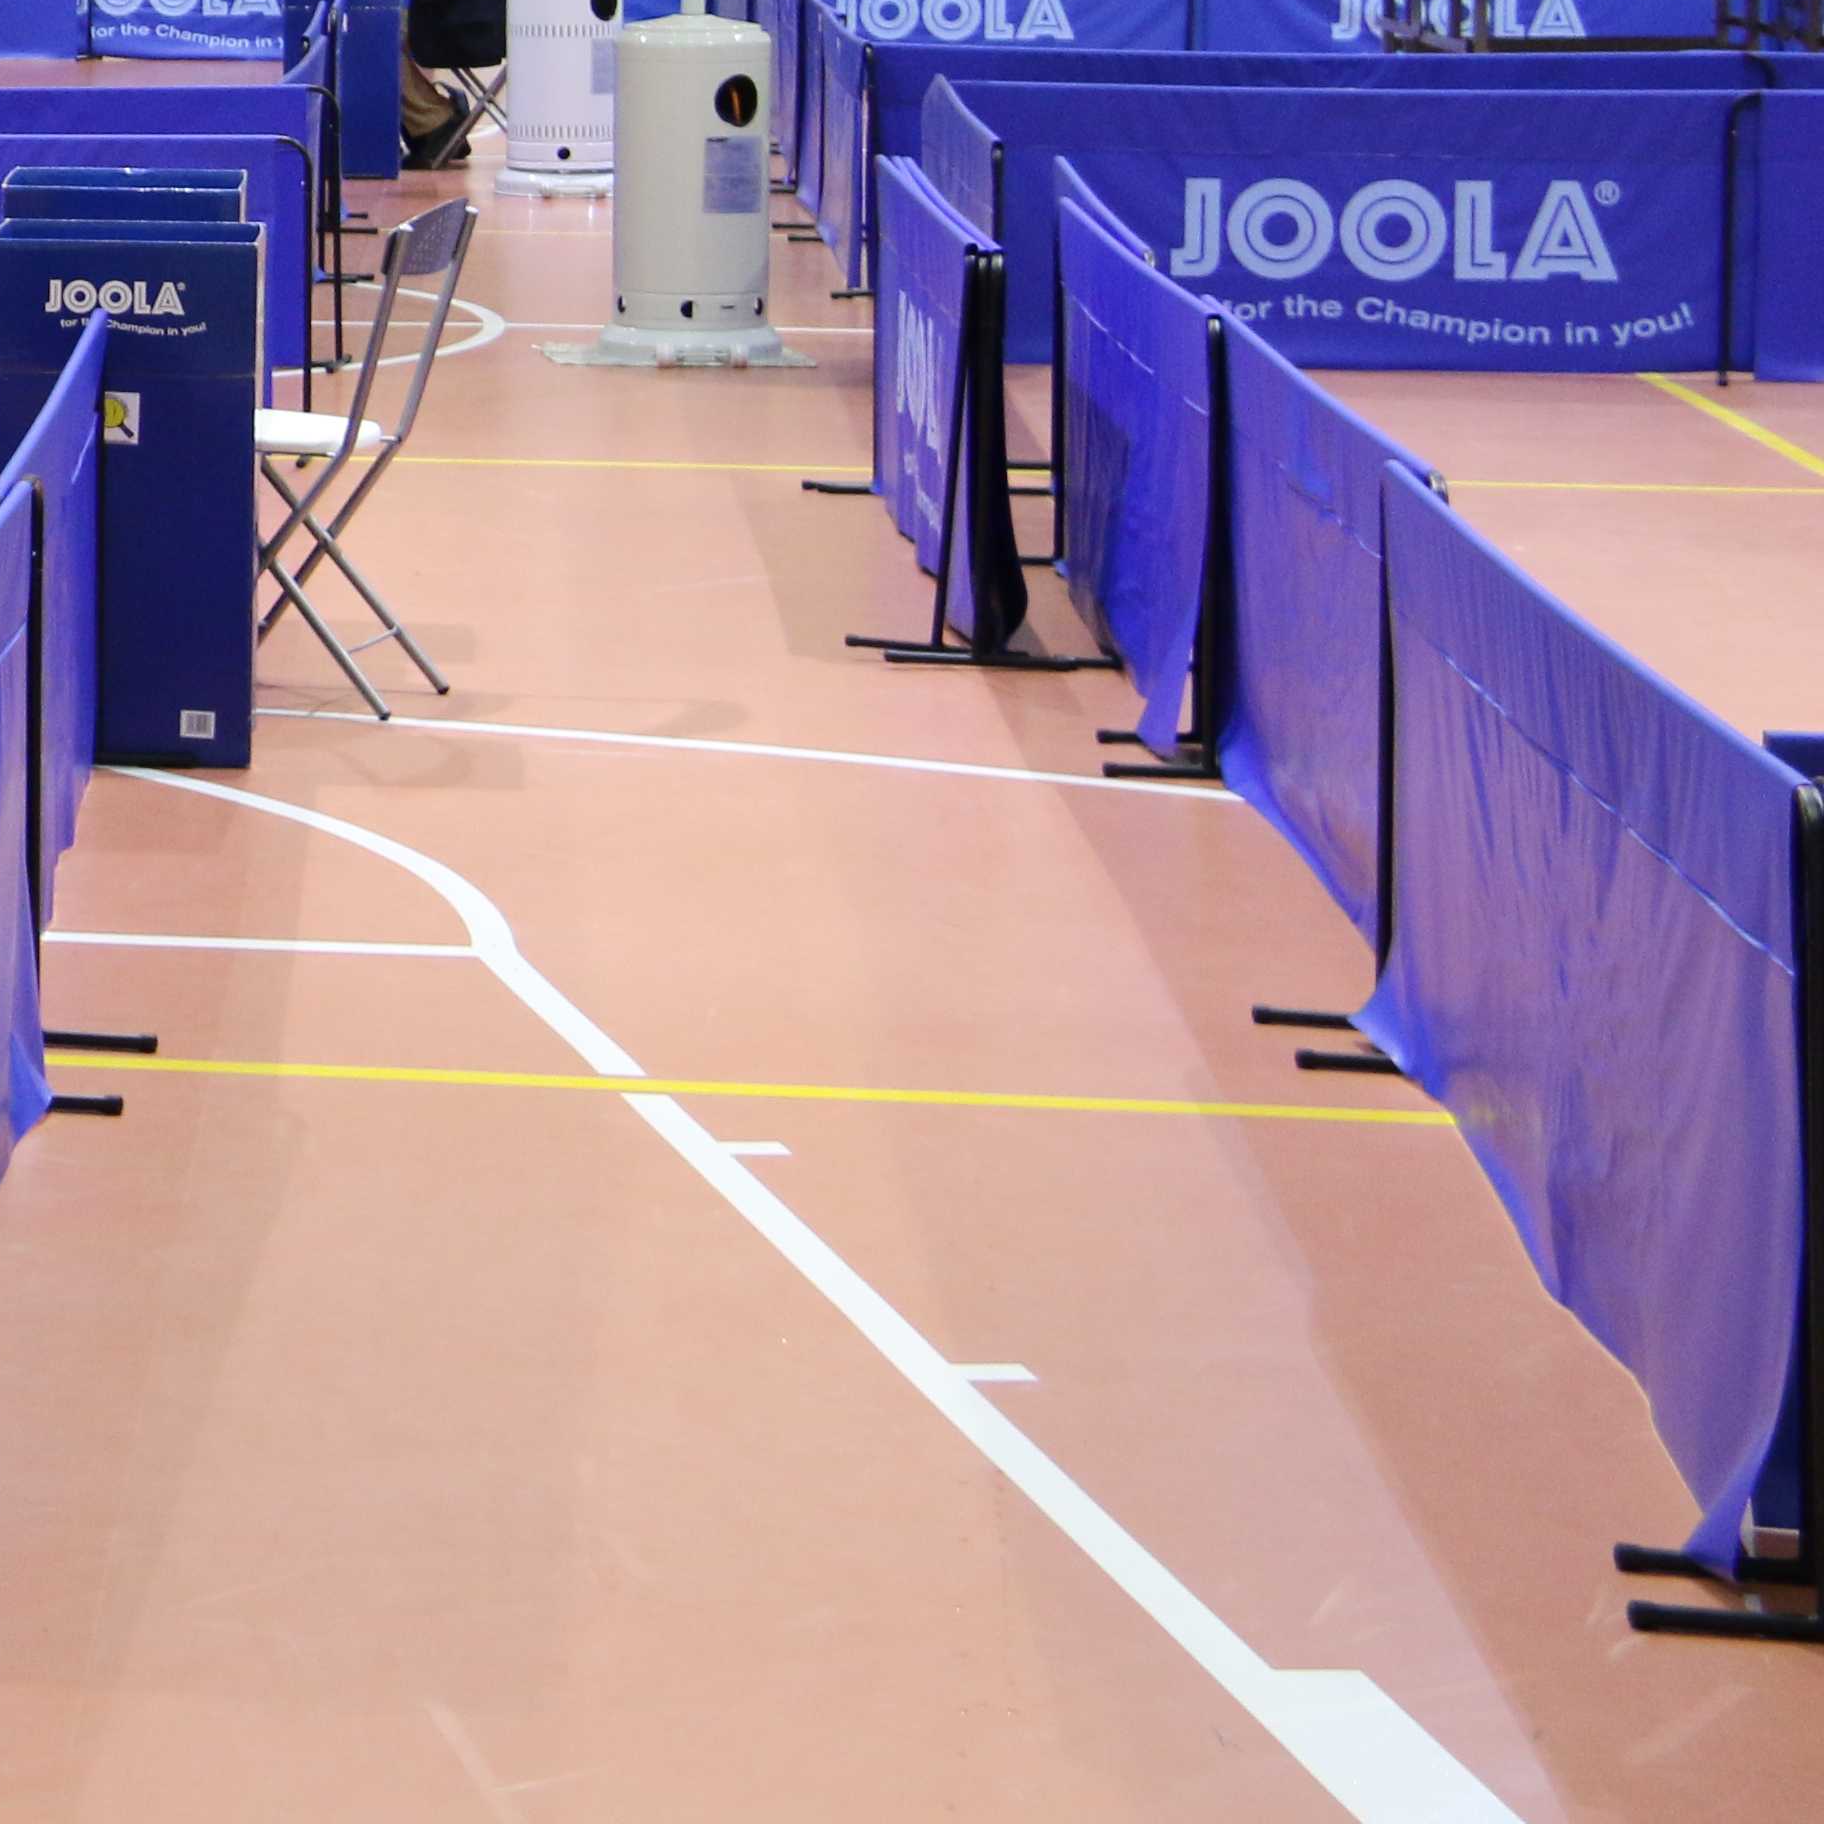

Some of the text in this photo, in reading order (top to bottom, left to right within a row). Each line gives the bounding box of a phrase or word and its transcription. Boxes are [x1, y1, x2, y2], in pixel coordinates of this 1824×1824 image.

[121, 22, 150, 37] the
[151, 23, 250, 48] Champion
[255, 35, 272, 48] in
[1171, 177, 1618, 282] JOOLA
[45, 279, 185, 315] JOOLA
[60, 319, 77, 329] for
[167, 326, 178, 336] in
[1283, 293, 1343, 320] the
[1355, 296, 1550, 345] Champion
[1566, 321, 1598, 345] in
[1612, 302, 1695, 347] you!
